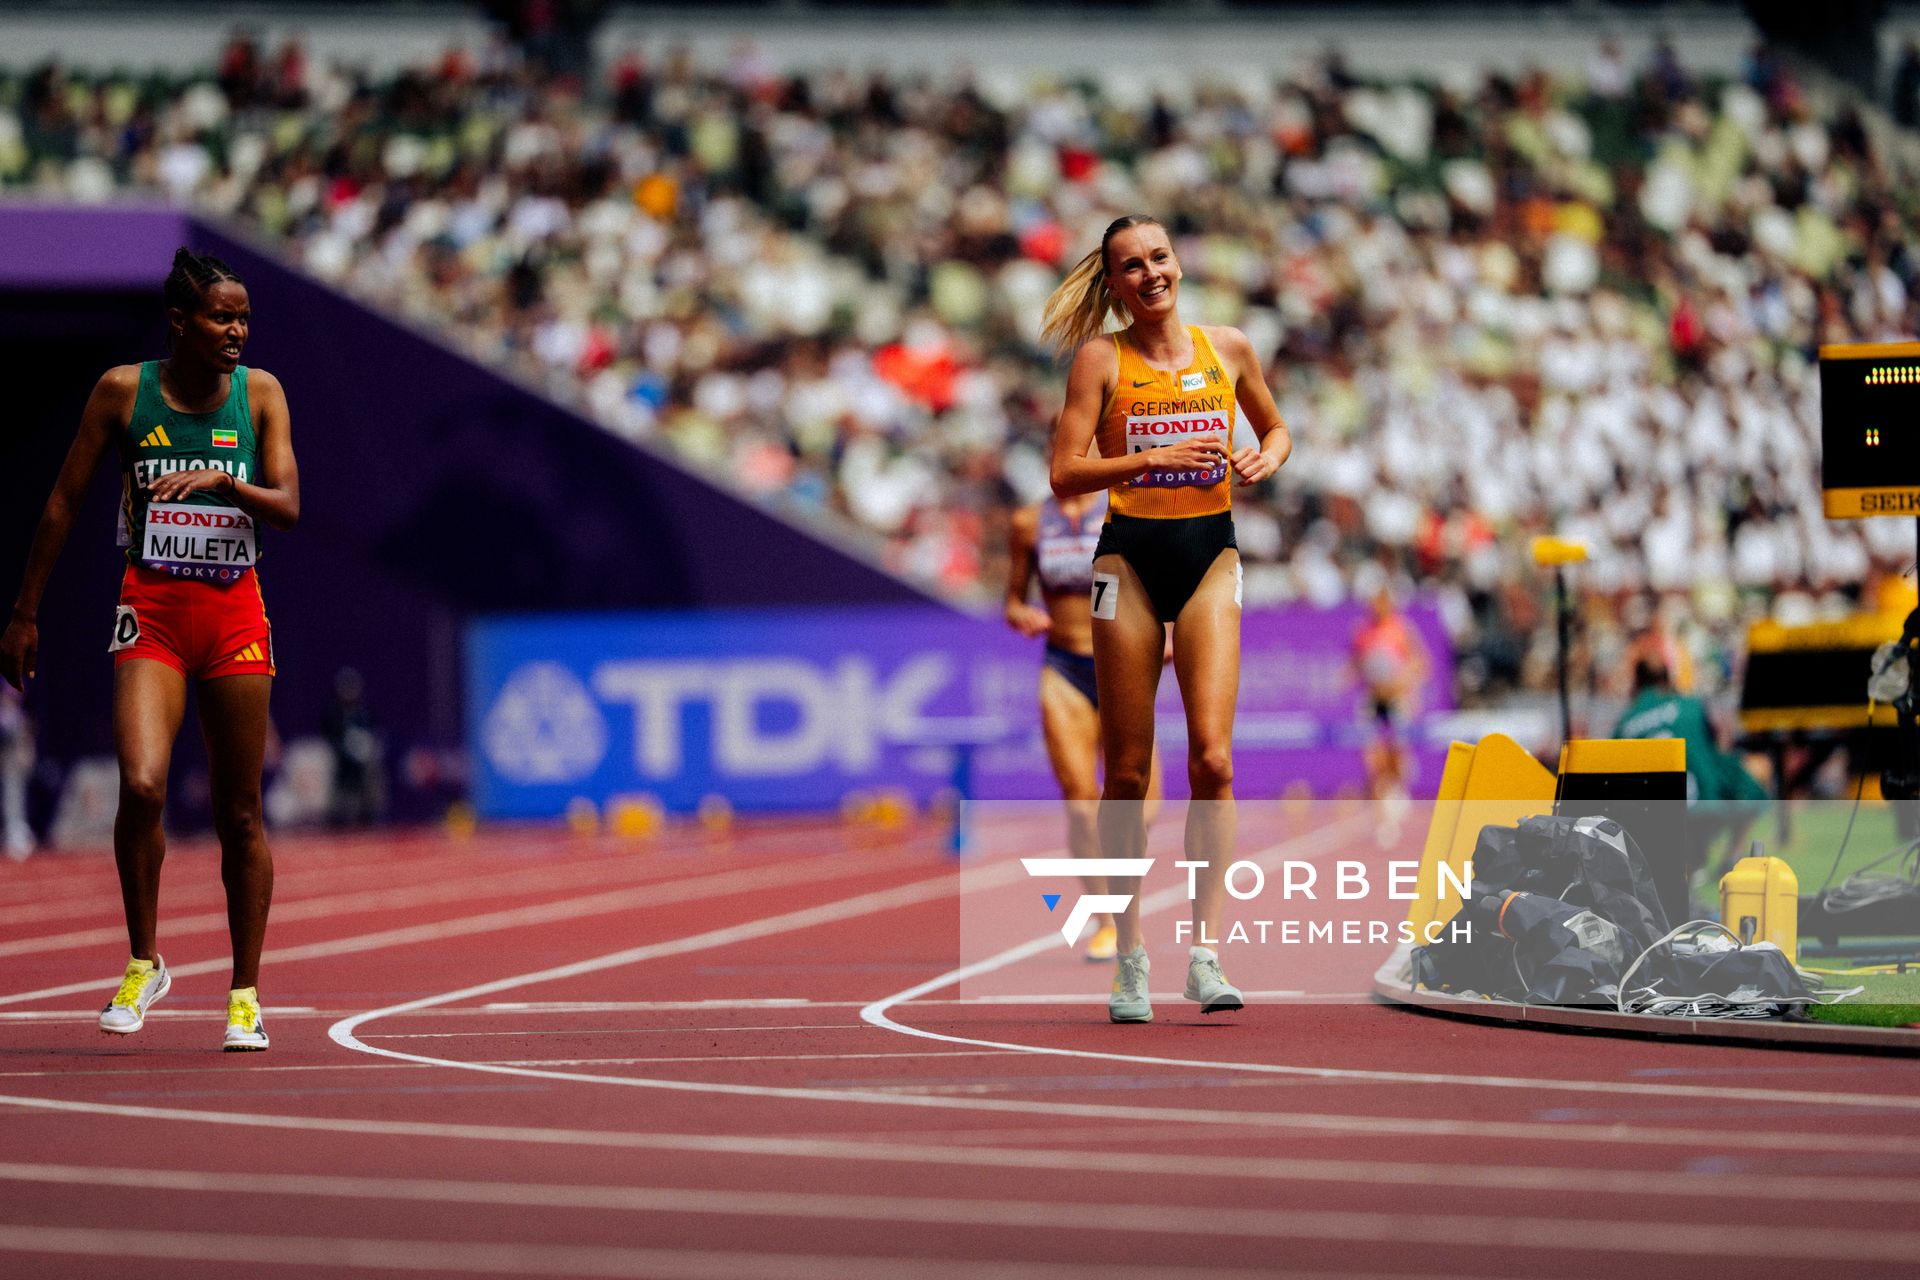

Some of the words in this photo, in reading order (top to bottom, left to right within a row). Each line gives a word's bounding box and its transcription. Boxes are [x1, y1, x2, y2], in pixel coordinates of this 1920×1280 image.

[1182, 376, 1204, 388] WGV
[1131, 394, 1223, 416] GERMANY
[1128, 417, 1227, 436] HONDA
[149, 509, 253, 530] HONDA
[150, 534, 250, 562] MULETA
[1094, 580, 1109, 612] 7
[116, 612, 139, 644] 0
[595, 654, 950, 777] TDK
